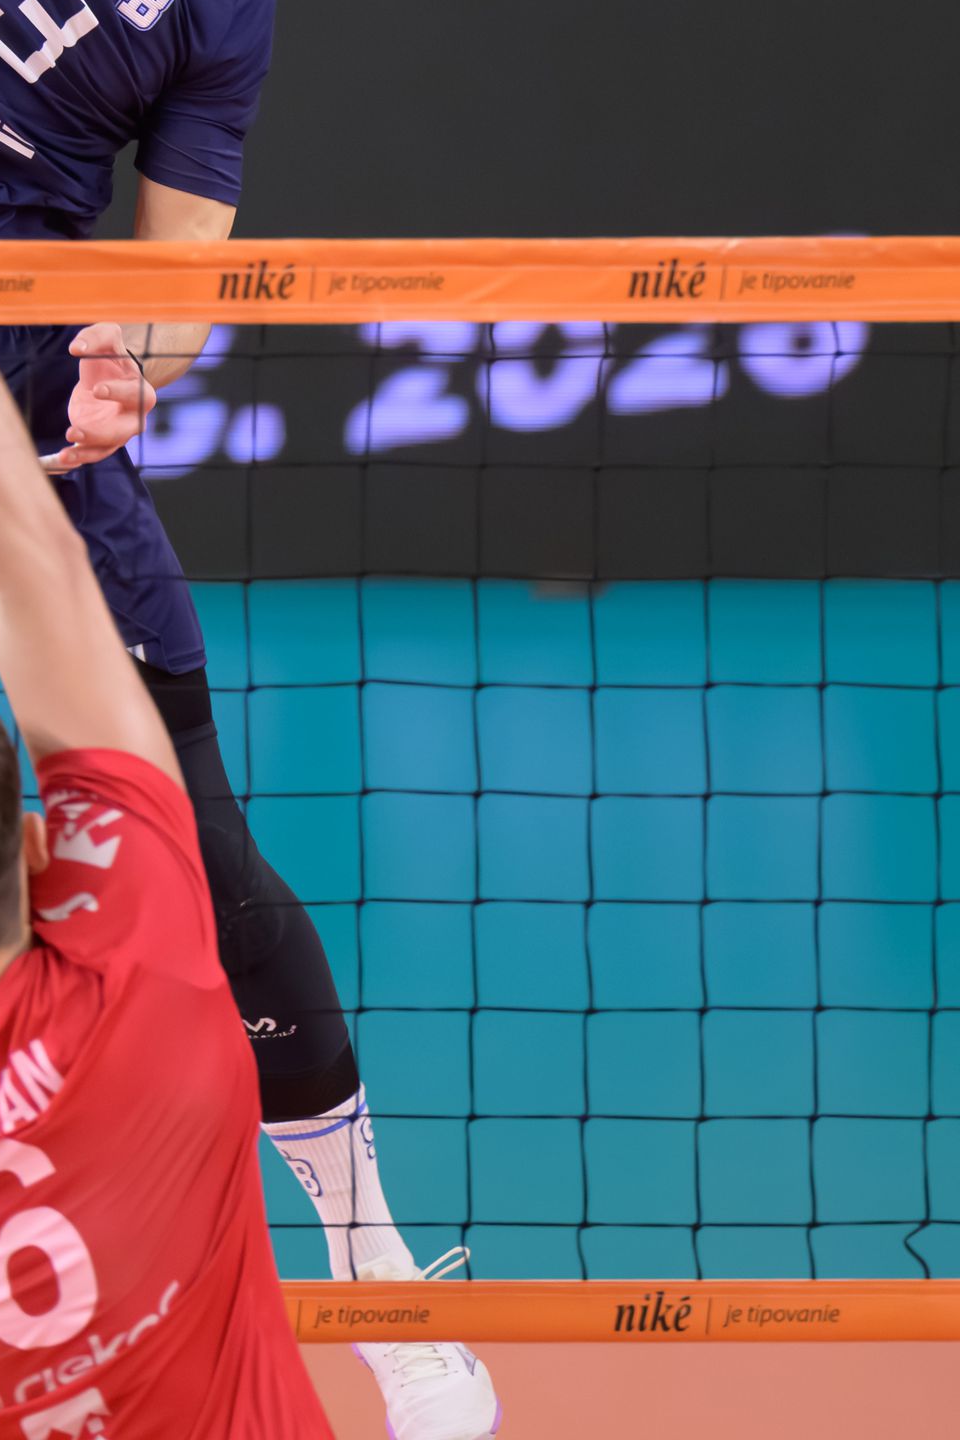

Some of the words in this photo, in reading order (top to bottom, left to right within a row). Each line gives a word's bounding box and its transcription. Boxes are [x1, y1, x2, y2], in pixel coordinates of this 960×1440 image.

[218, 260, 296, 300] niké
[351, 271, 445, 294] tipovanie
[627, 259, 706, 299] niké
[761, 270, 856, 293] tipovanie
[313, 1305, 334, 1329] je
[338, 1304, 431, 1328] tipovanie
[613, 1291, 692, 1333] niké
[723, 1304, 742, 1328] je
[746, 1304, 840, 1328] tipovanie
